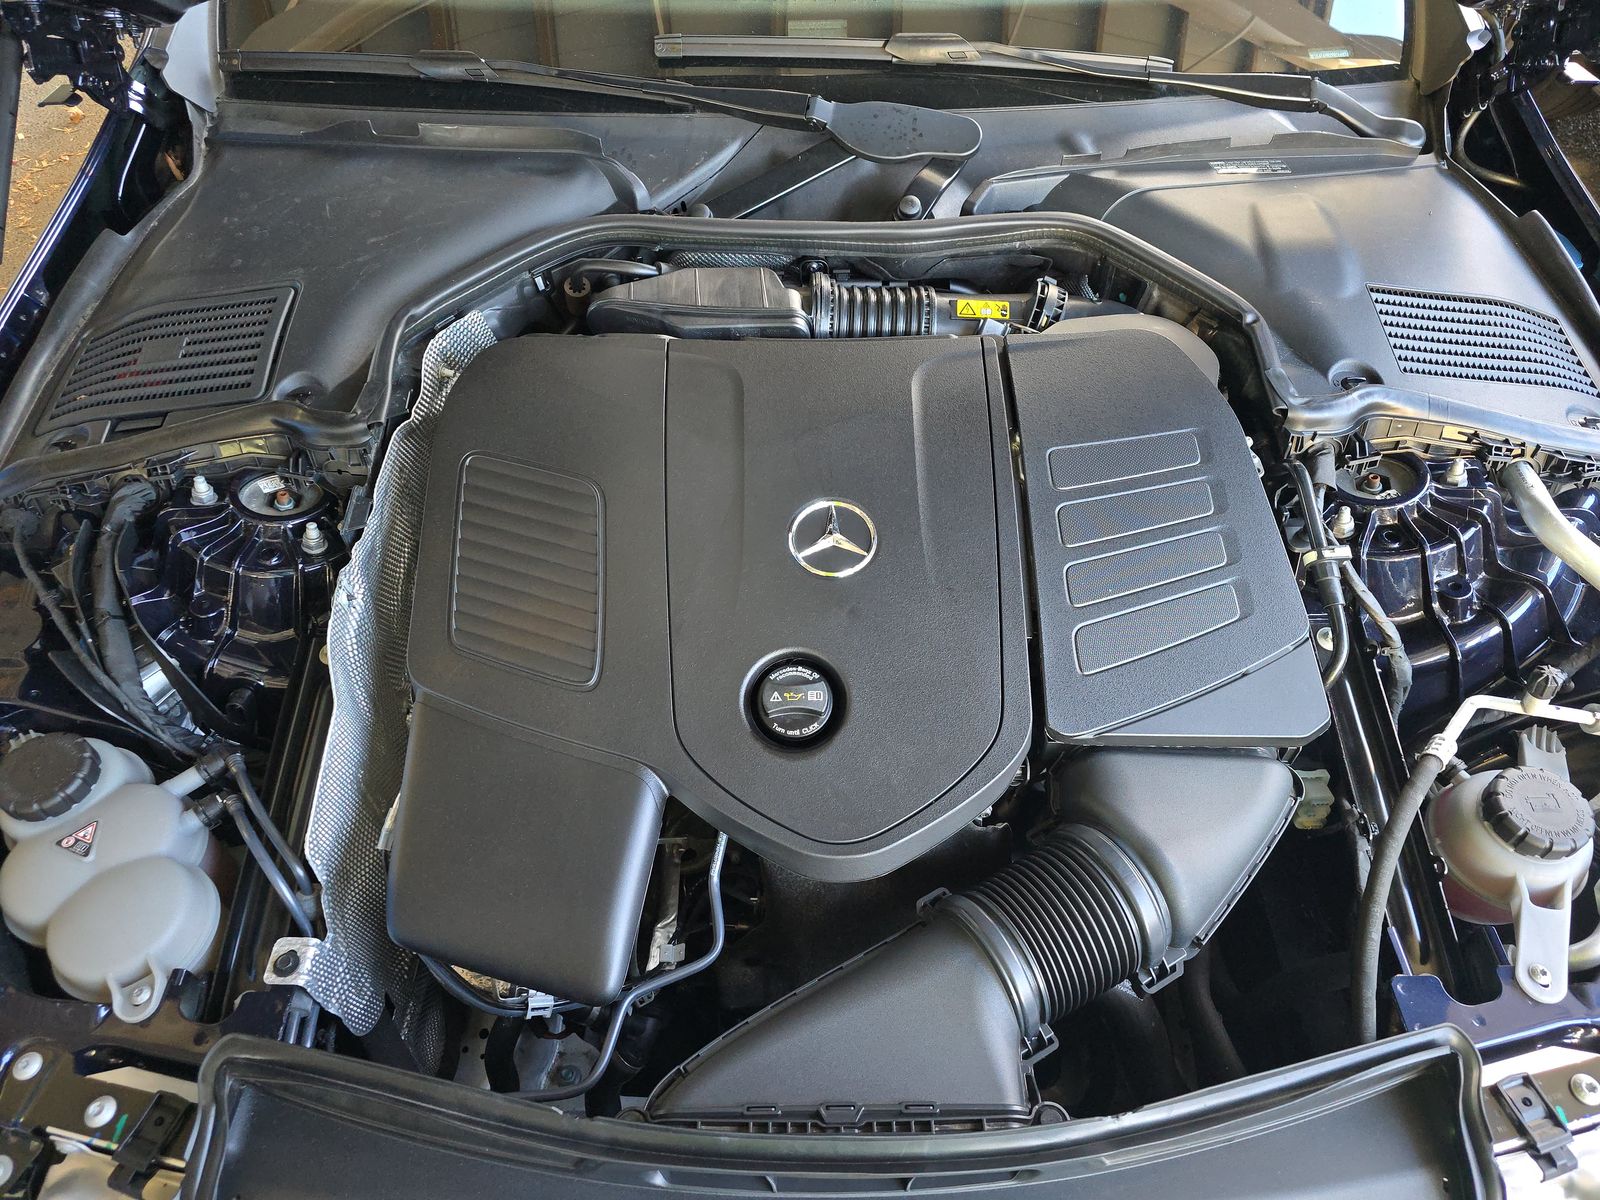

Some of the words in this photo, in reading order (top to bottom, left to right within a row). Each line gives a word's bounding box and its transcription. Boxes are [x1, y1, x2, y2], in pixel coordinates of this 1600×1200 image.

[776, 671, 814, 681] recommended
[772, 722, 785, 734] Turn
[801, 722, 819, 734] CLICK
[1517, 772, 1537, 782] OPEN
[1539, 773, 1562, 789] WHEN
